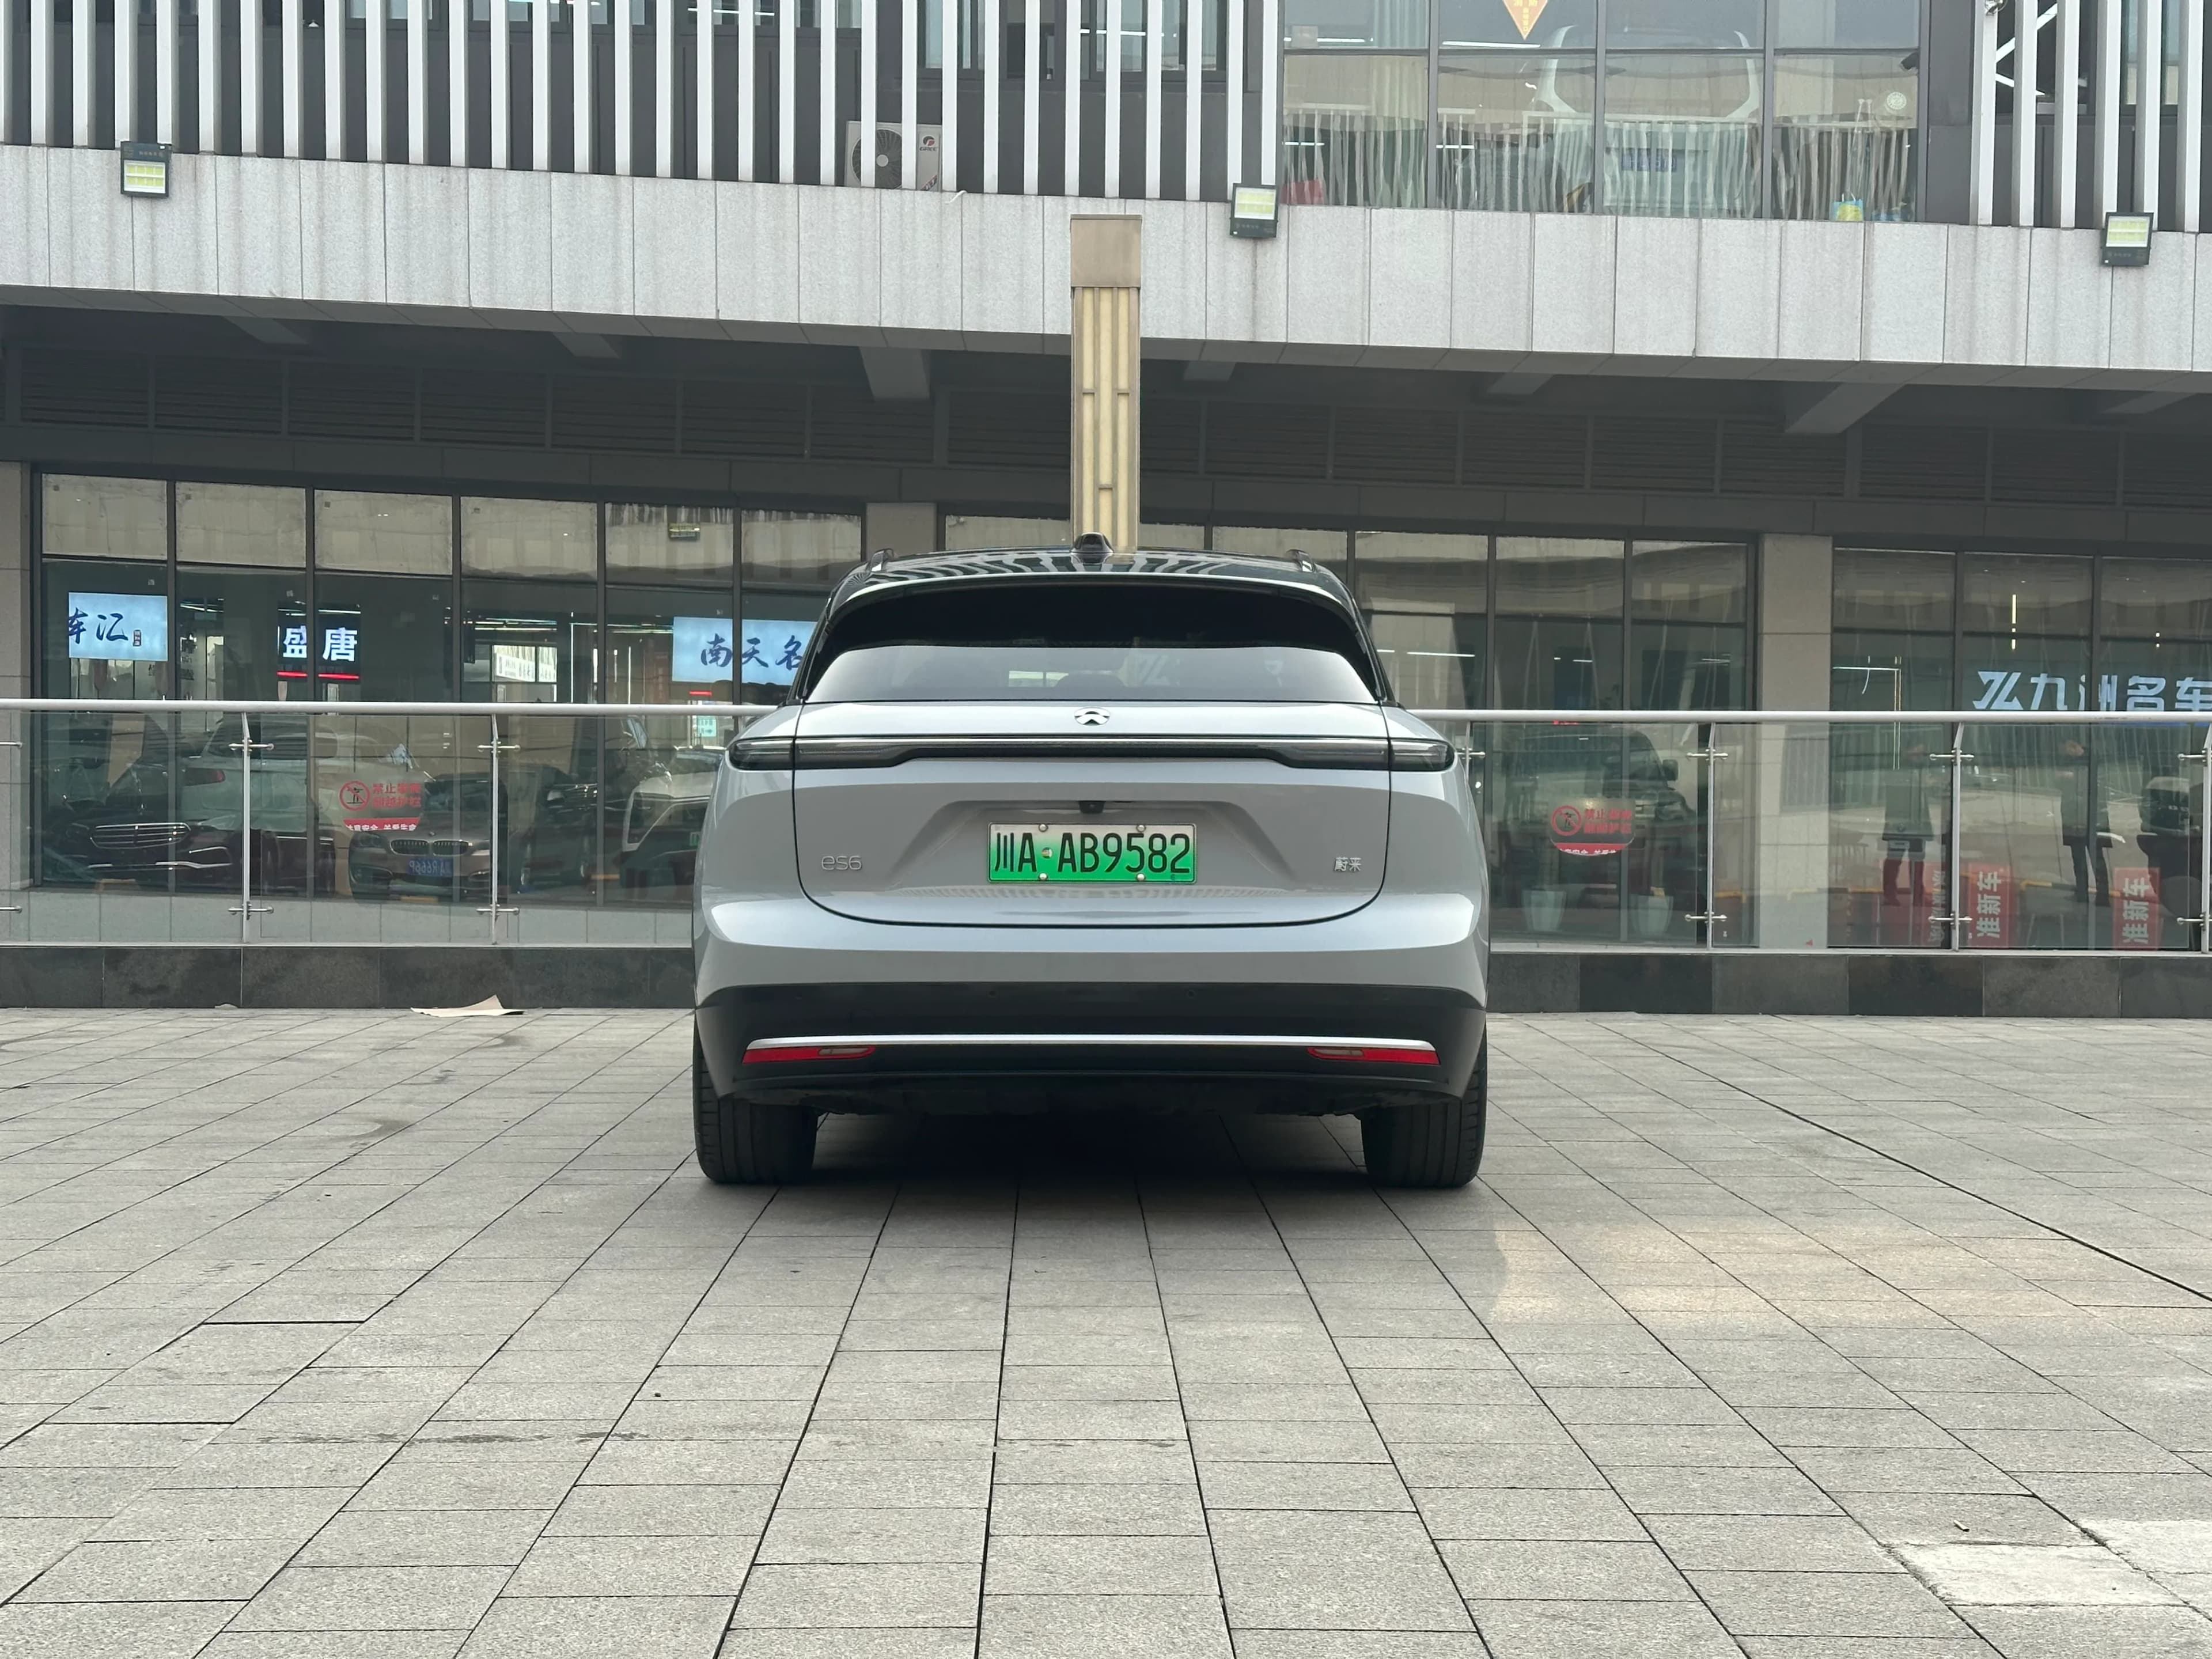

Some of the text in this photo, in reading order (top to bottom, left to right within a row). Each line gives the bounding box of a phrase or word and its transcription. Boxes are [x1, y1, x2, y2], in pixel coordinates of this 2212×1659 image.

[283, 626, 358, 661] 盛唐
[1334, 857, 1361, 871] 蔚来
[1976, 871, 2002, 938] 准新车
[2122, 877, 2150, 944] 准新车
